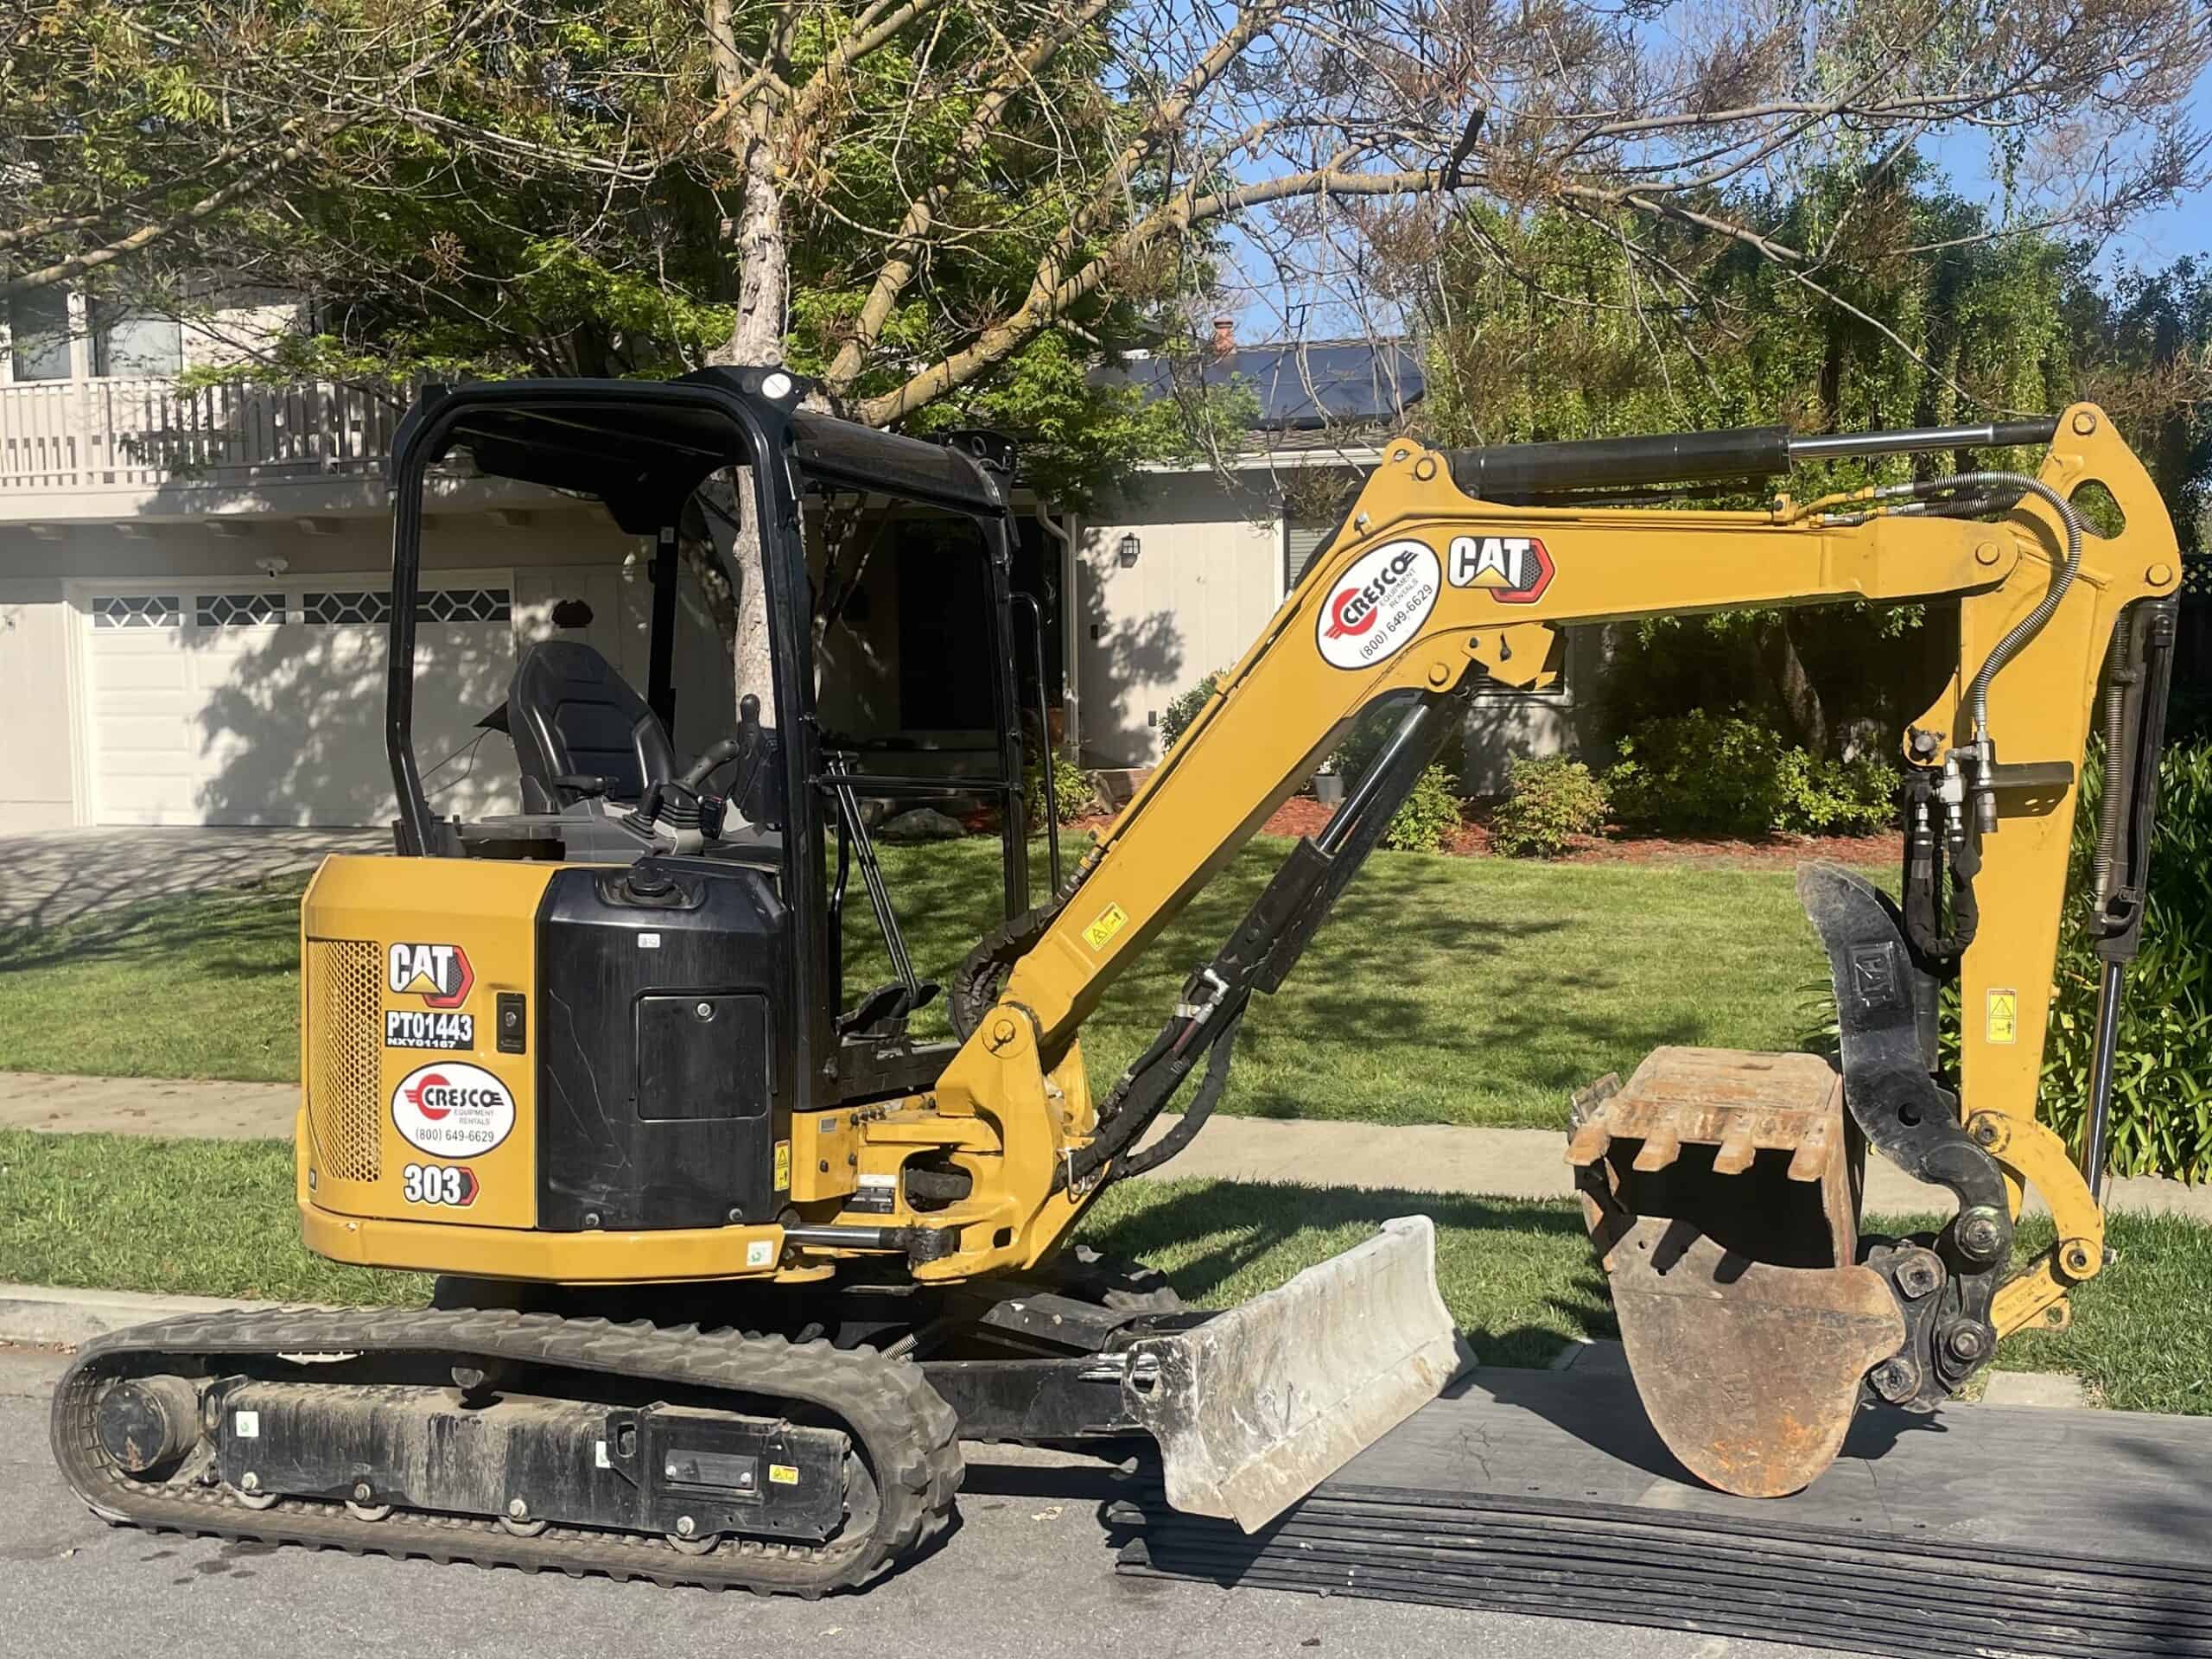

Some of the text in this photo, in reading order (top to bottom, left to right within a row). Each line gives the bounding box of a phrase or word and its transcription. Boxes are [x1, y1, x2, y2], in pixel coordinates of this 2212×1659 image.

[1449, 537, 1529, 588] CAT
[1343, 550, 1419, 624] CRESCO
[1359, 584, 1433, 660] (800) 649-6629
[390, 944, 454, 994] CAT
[387, 1011, 473, 1042] PT01443
[424, 1087, 505, 1108] CRESCO
[416, 1127, 494, 1143] (800) 649-6629
[459, 1117, 491, 1126] RENTALS
[404, 1163, 461, 1205] 303
